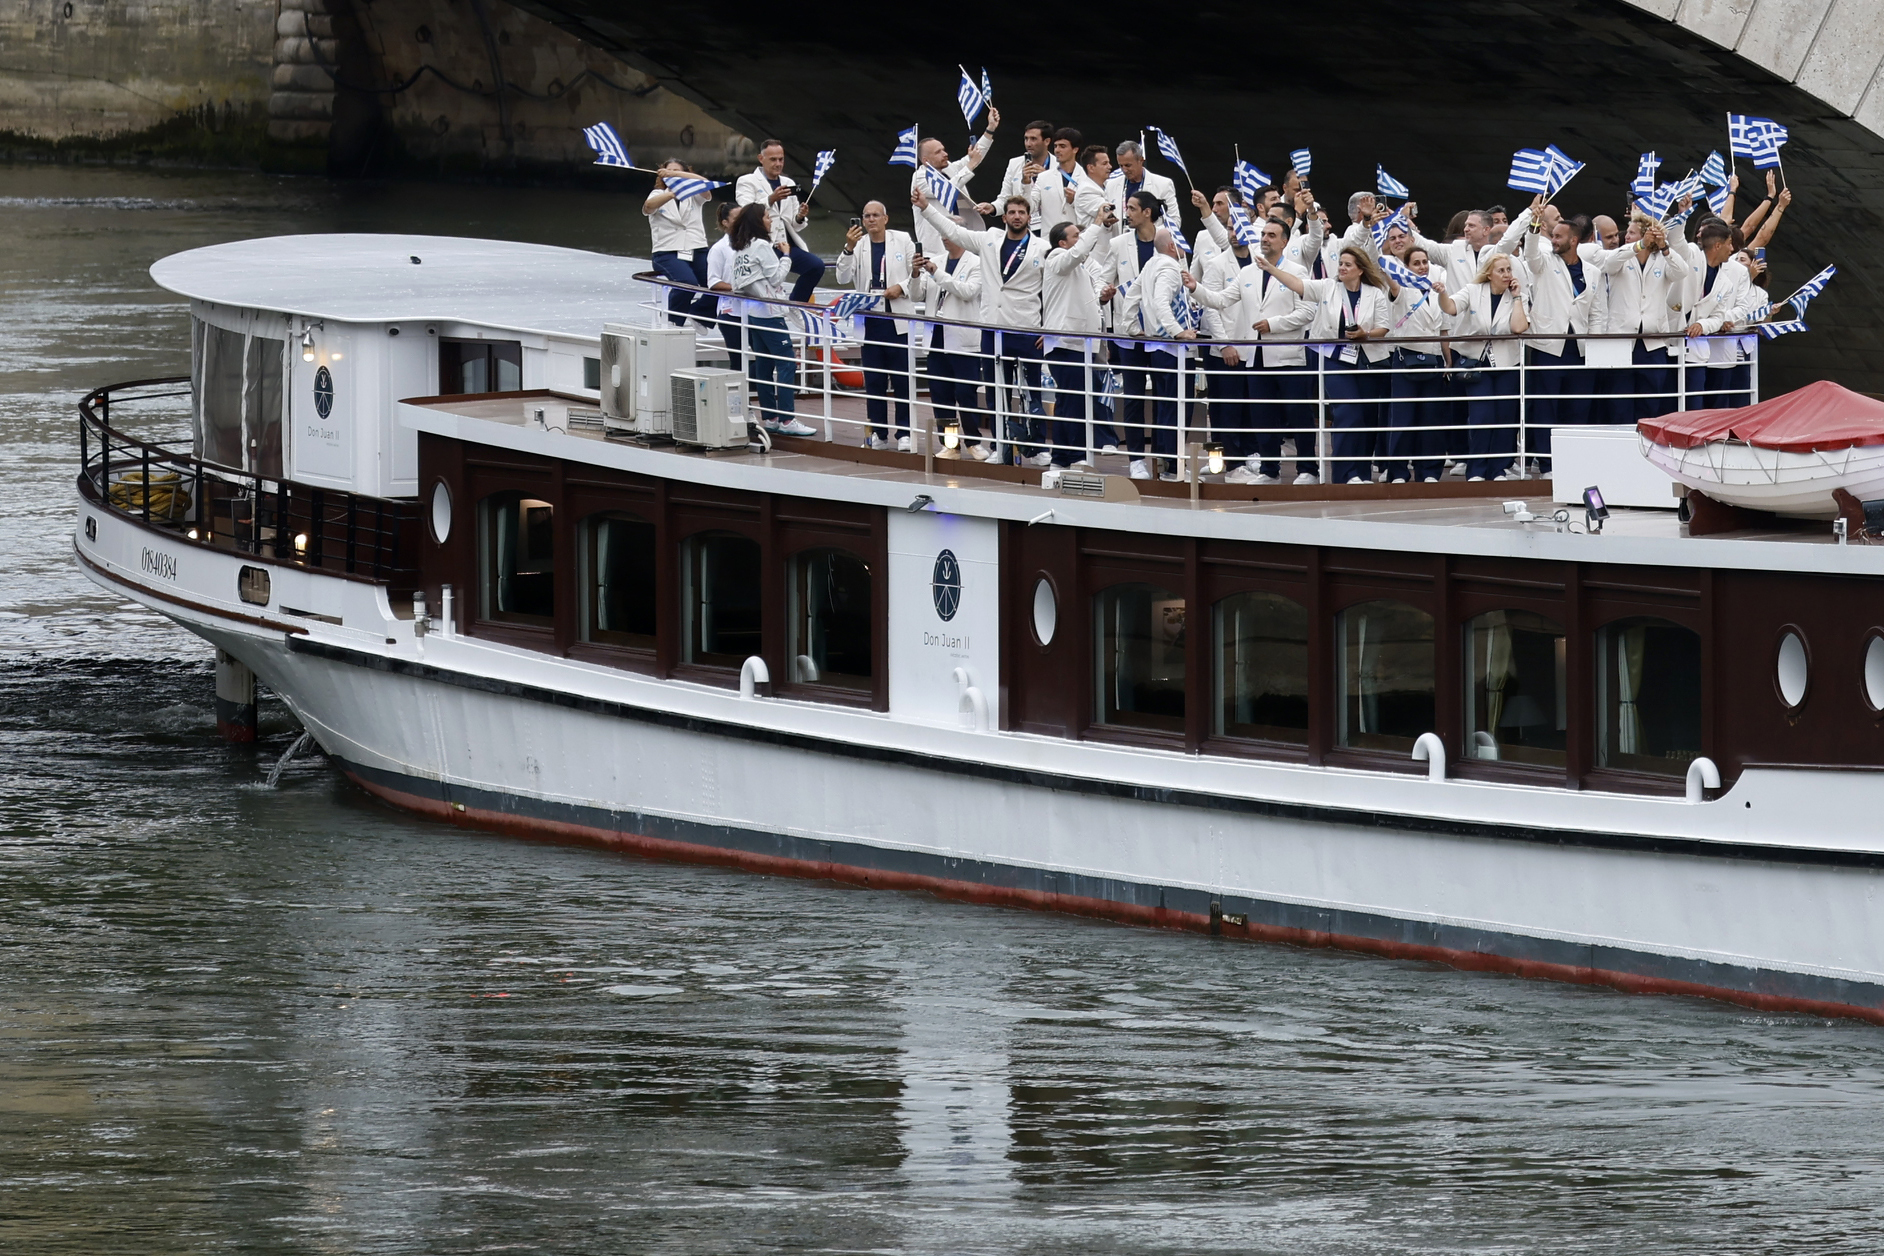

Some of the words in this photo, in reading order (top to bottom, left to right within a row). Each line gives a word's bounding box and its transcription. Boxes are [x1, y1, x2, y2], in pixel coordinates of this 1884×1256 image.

[307, 425, 319, 438] Don
[141, 546, 177, 581] 01840384
[923, 631, 939, 646] Don
[941, 633, 961, 649] Juan
